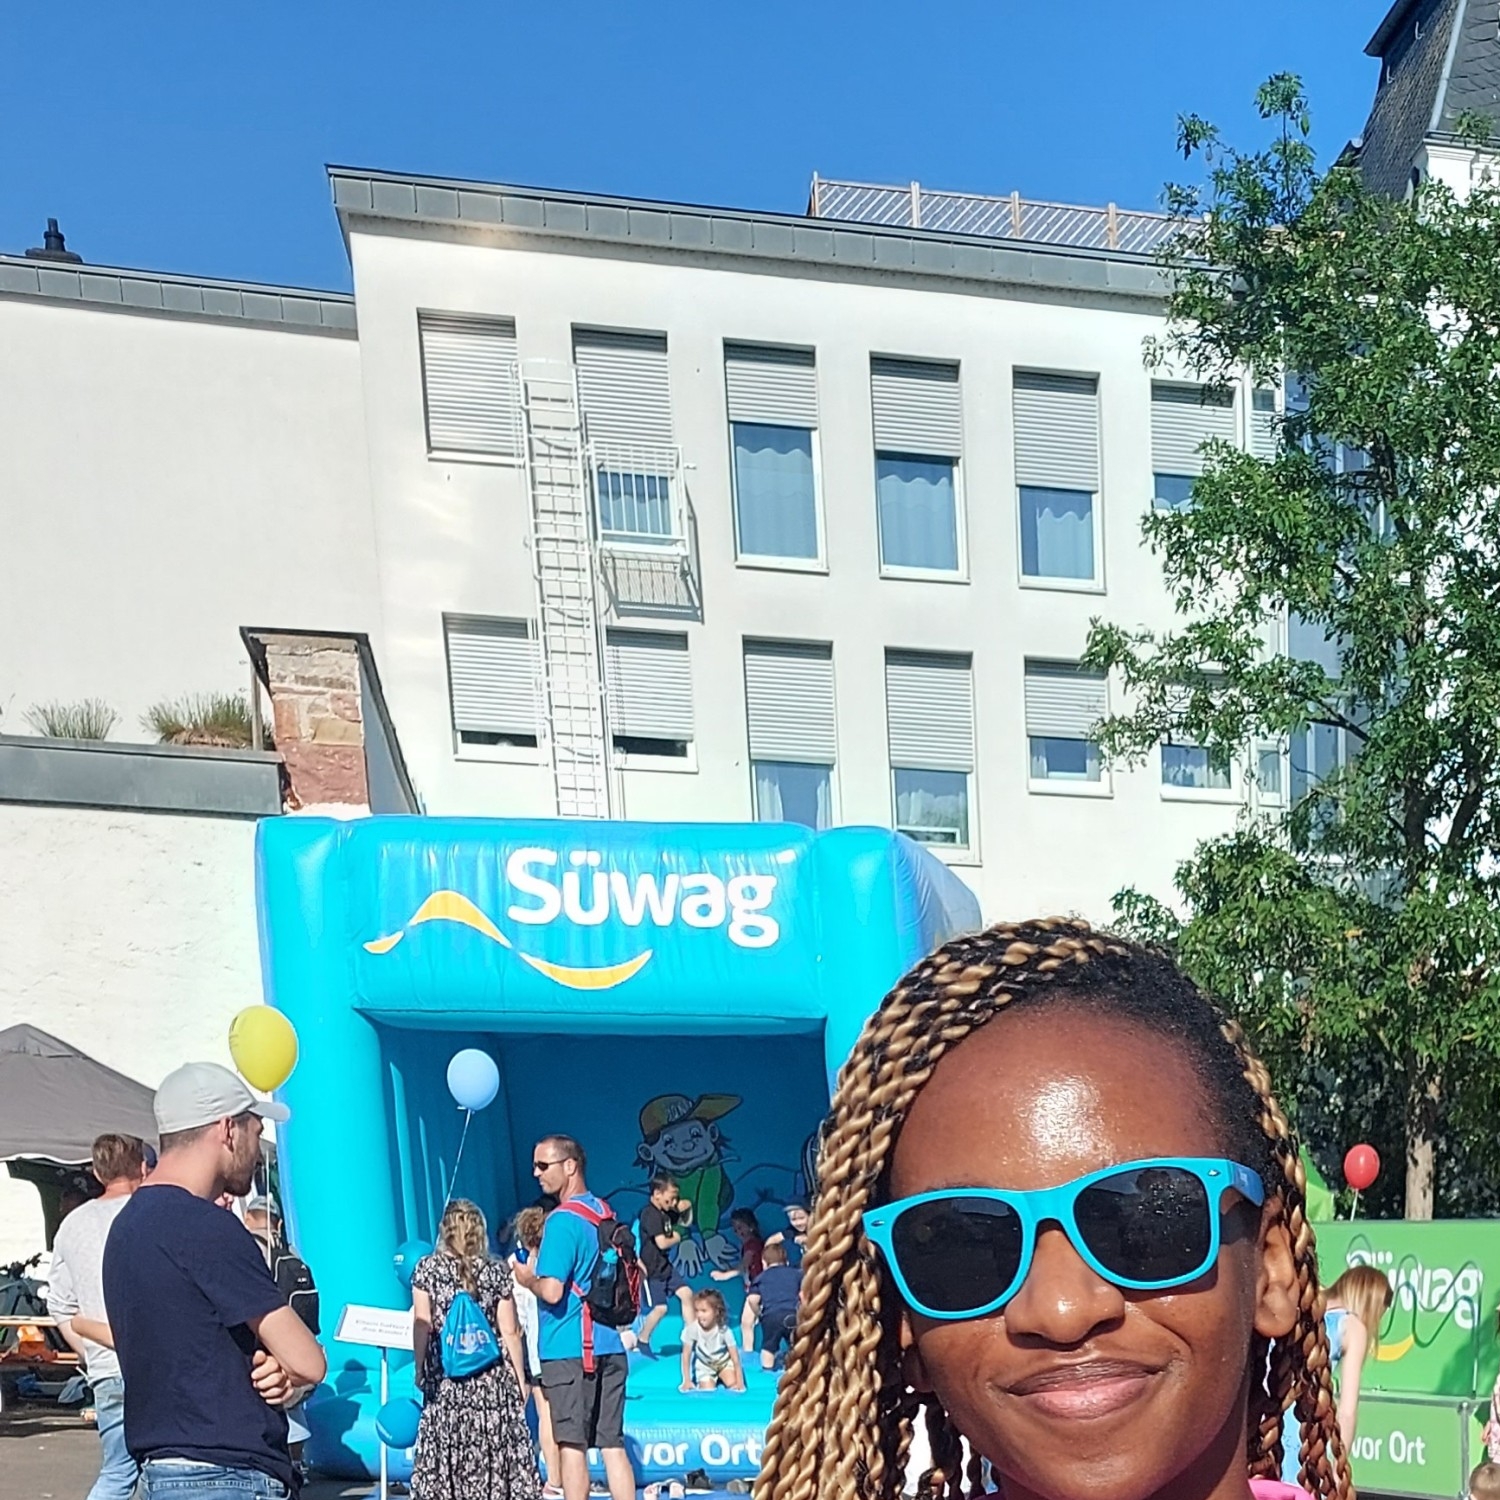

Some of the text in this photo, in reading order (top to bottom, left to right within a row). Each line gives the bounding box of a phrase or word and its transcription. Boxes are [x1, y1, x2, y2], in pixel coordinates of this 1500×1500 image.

[506, 846, 780, 948] Süwag
[632, 1441, 689, 1466] vor
[701, 1433, 763, 1466] Ort
[1352, 1431, 1426, 1465] vor Ort
